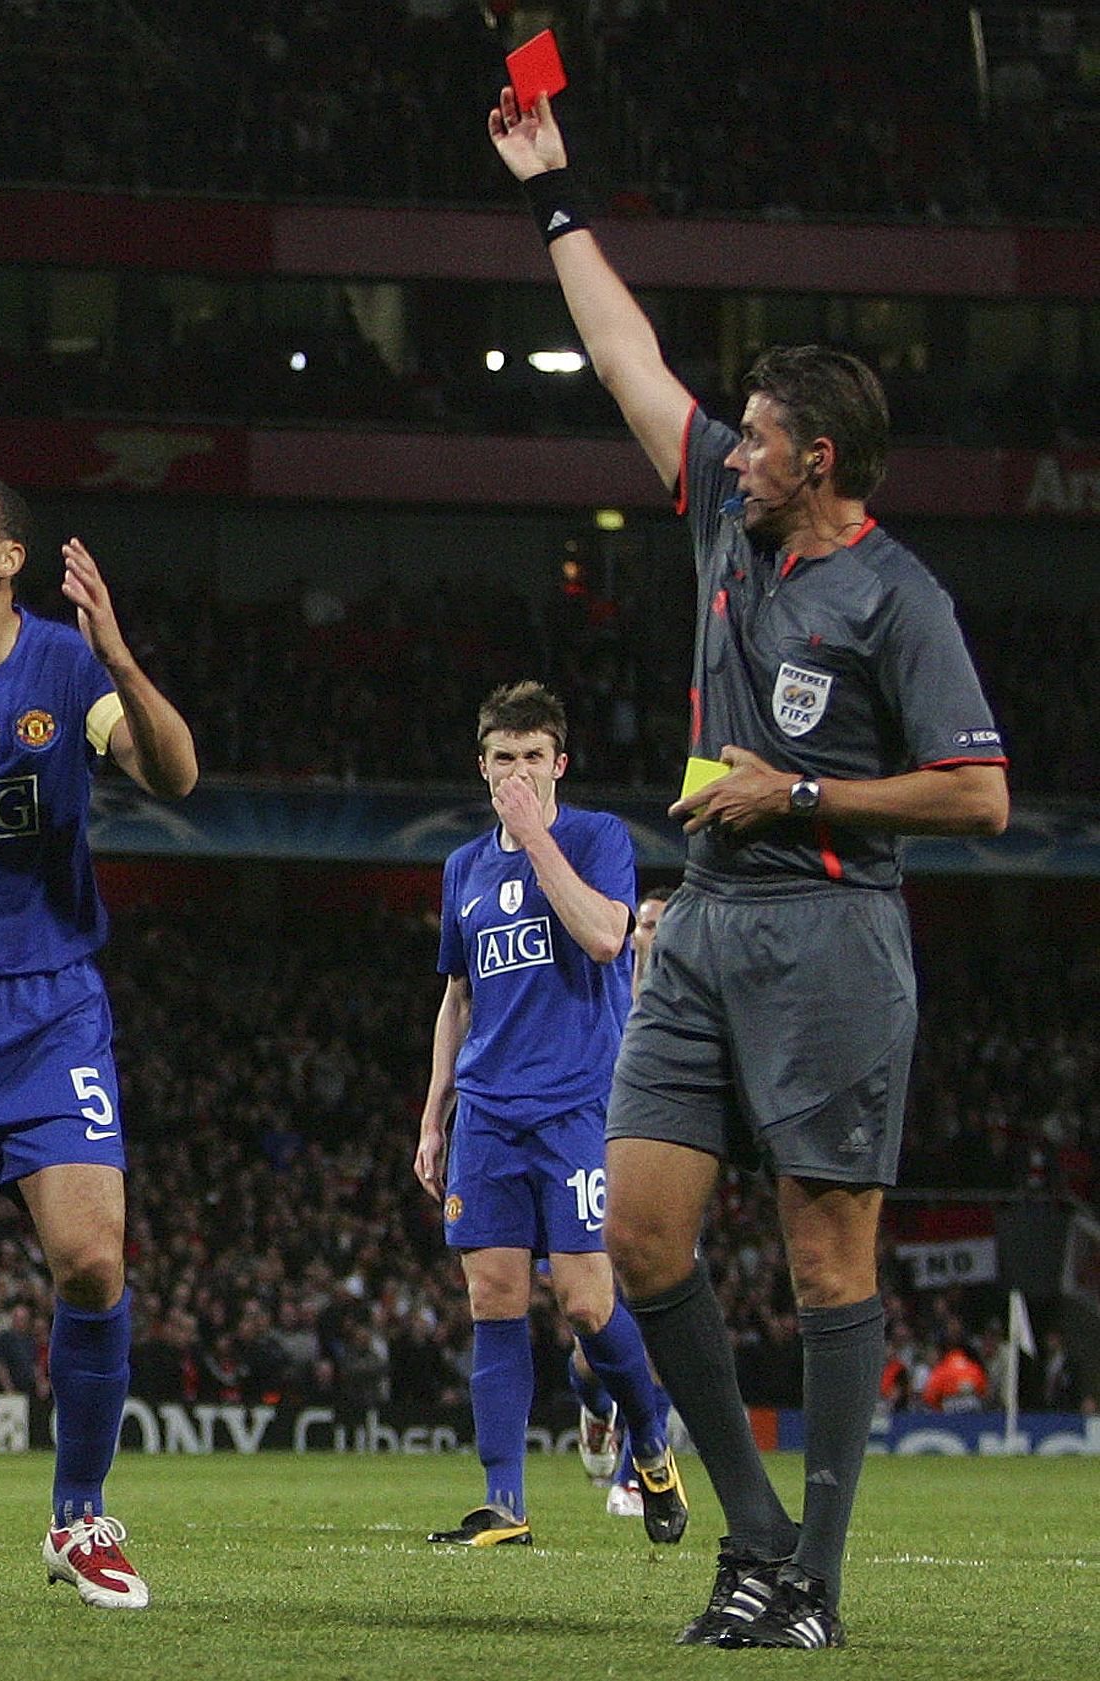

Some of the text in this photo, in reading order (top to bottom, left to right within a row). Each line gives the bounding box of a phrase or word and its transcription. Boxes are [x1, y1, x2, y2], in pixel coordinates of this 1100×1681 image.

[780, 705, 811, 724] FIFA
[483, 924, 546, 971] AIG
[69, 1066, 113, 1126] 5
[566, 1168, 606, 1220] 16
[116, 1401, 276, 1454] ONY
